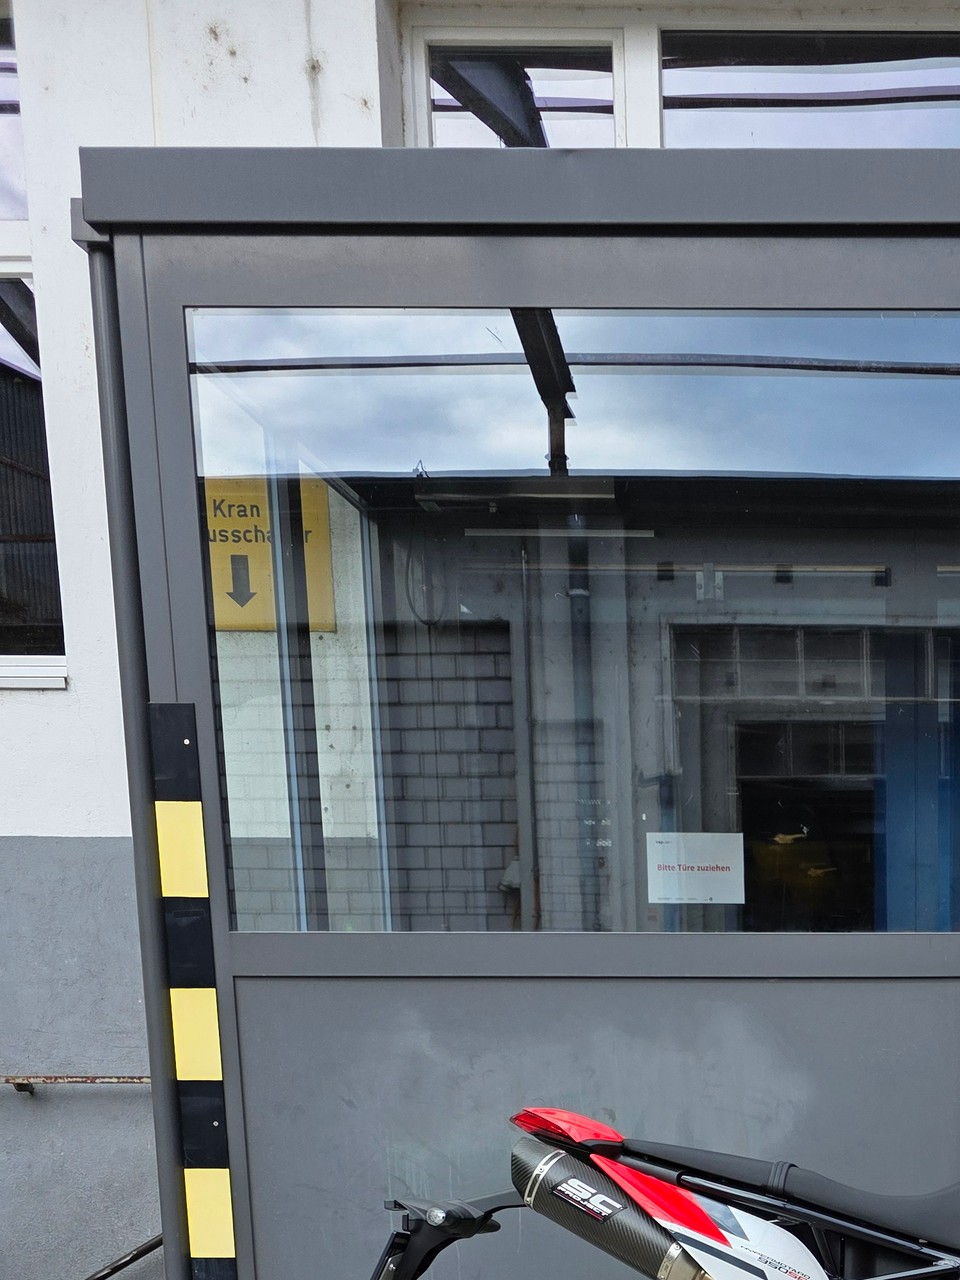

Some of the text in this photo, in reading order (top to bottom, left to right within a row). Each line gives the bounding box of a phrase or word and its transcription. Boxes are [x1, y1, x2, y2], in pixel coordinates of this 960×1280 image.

[213, 499, 260, 518] Kran
[657, 864, 731, 872] Bitte Türe zuziehen
[557, 1186, 609, 1216] PROJECT
[560, 1178, 623, 1214] SC
